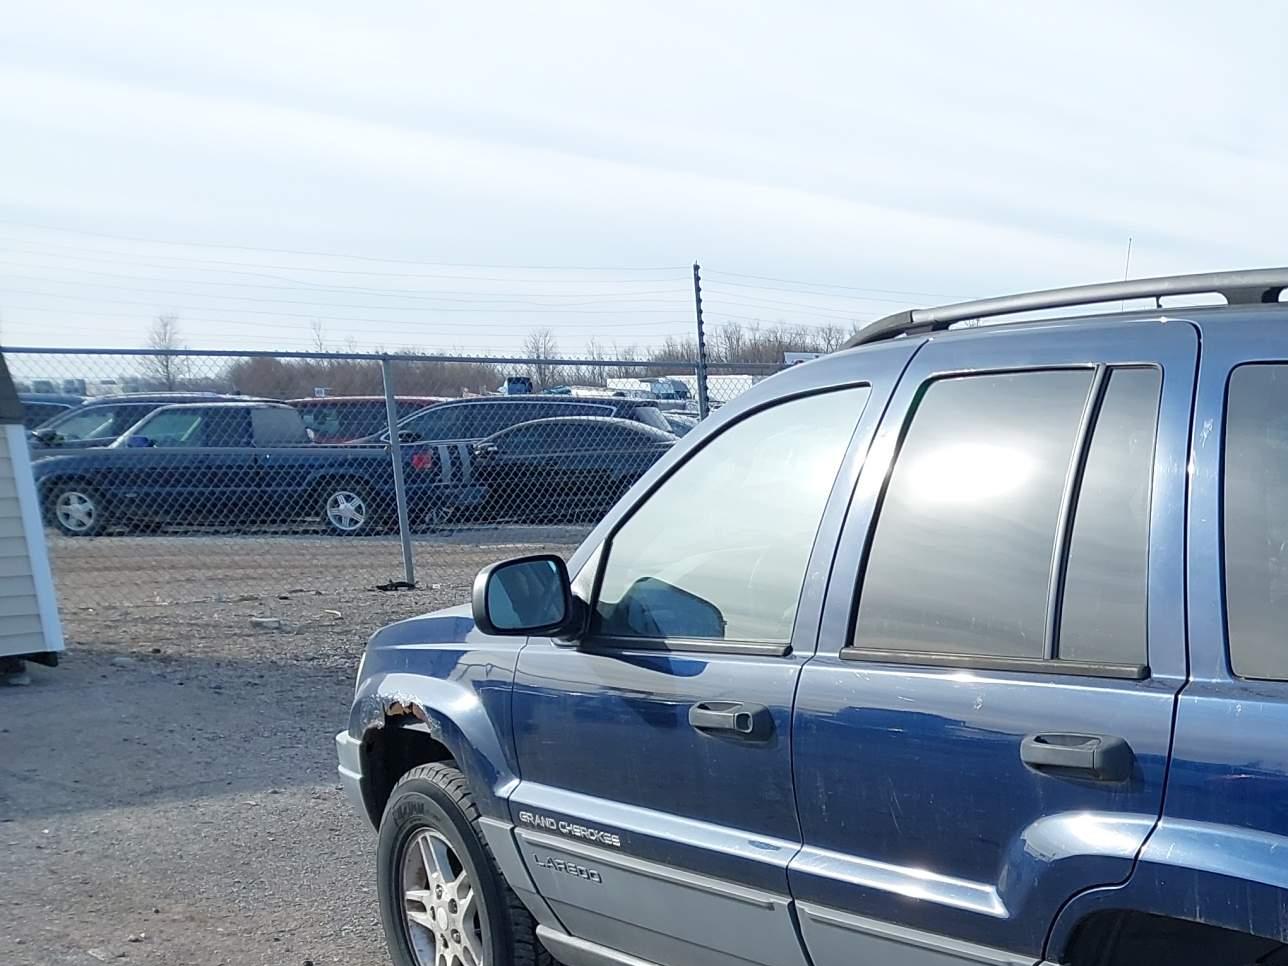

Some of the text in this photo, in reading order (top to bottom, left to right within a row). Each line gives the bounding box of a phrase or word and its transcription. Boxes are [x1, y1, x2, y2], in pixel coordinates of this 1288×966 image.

[519, 811, 620, 847] GRAND CHEROKEE
[533, 855, 603, 884] LAREDO
